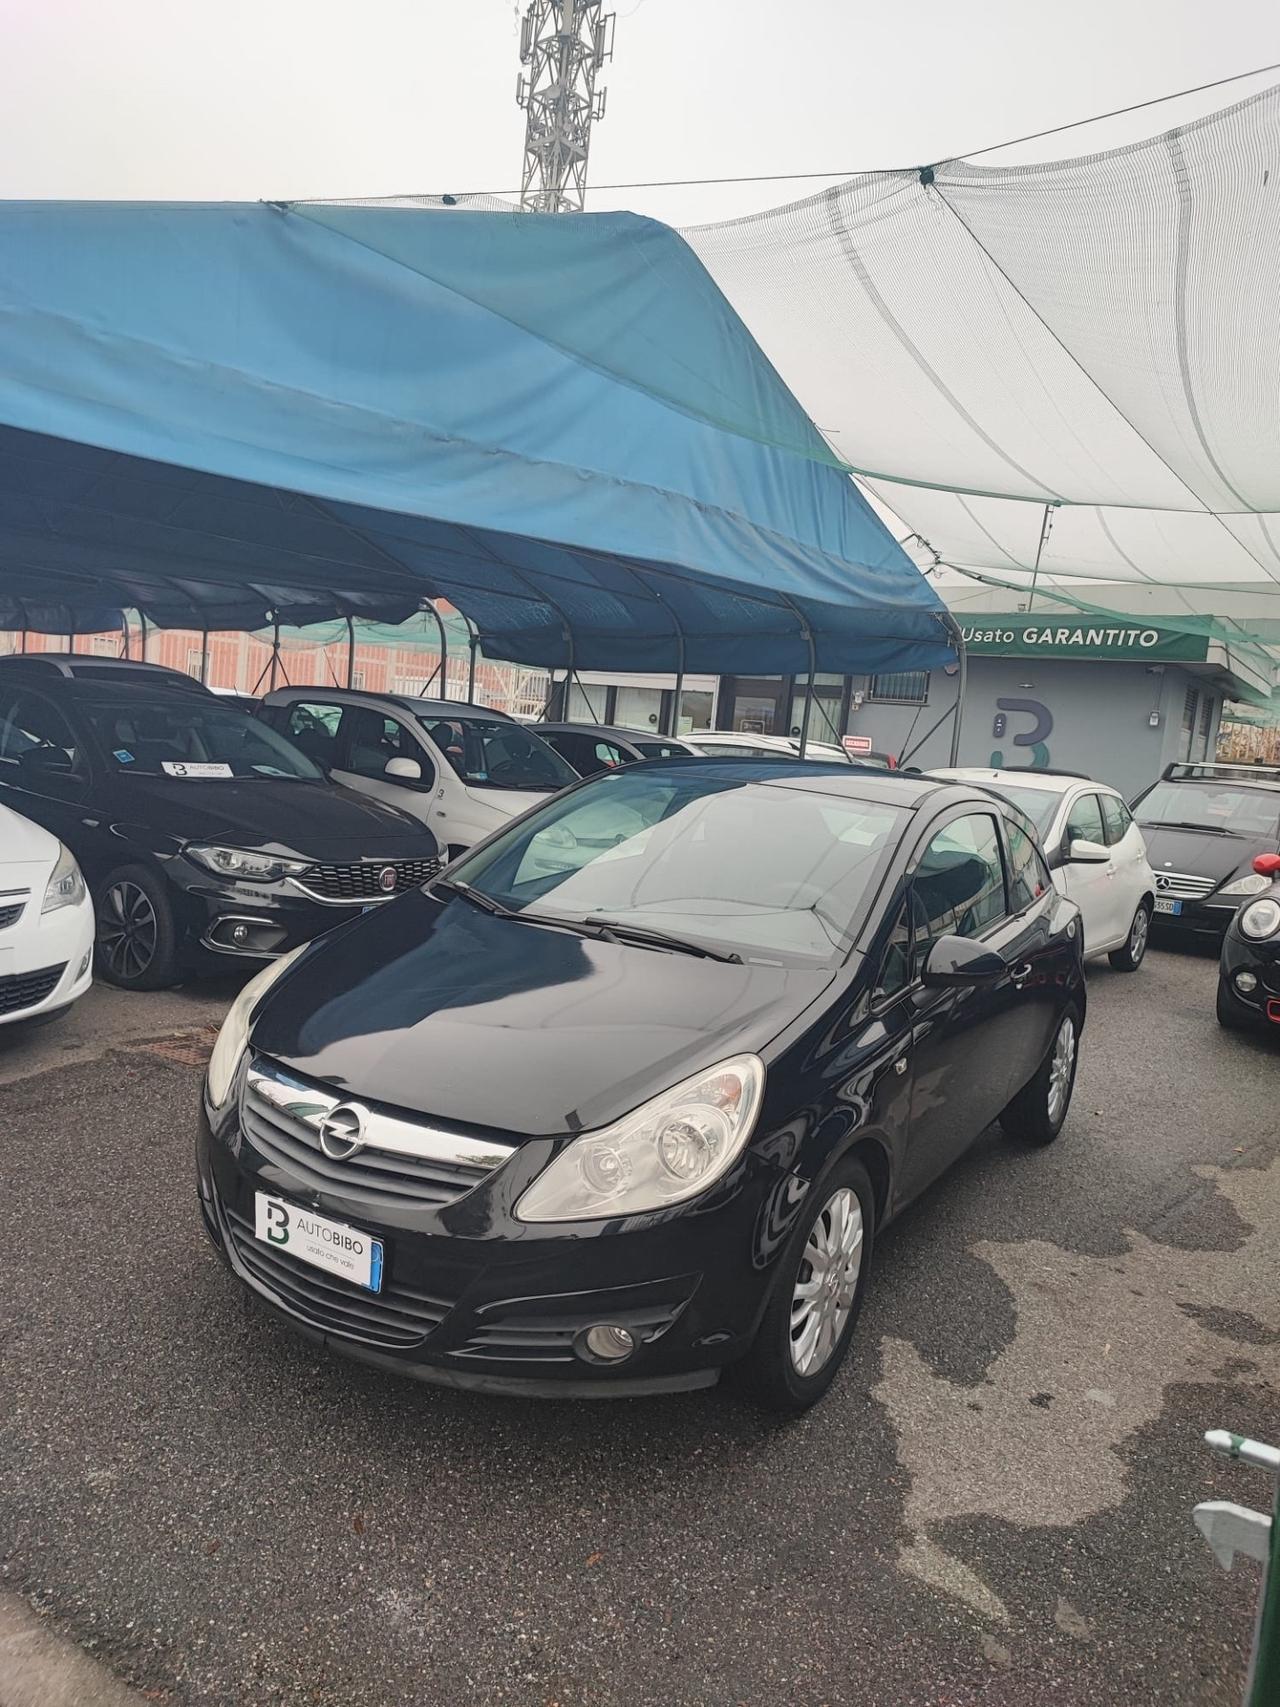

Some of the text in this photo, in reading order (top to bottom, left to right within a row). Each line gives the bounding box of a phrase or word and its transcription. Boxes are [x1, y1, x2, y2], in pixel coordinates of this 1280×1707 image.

[961, 627, 1158, 647] Usato GARANTITO
[297, 1218, 364, 1255] AUTOBIBO
[306, 1244, 325, 1257] usato
